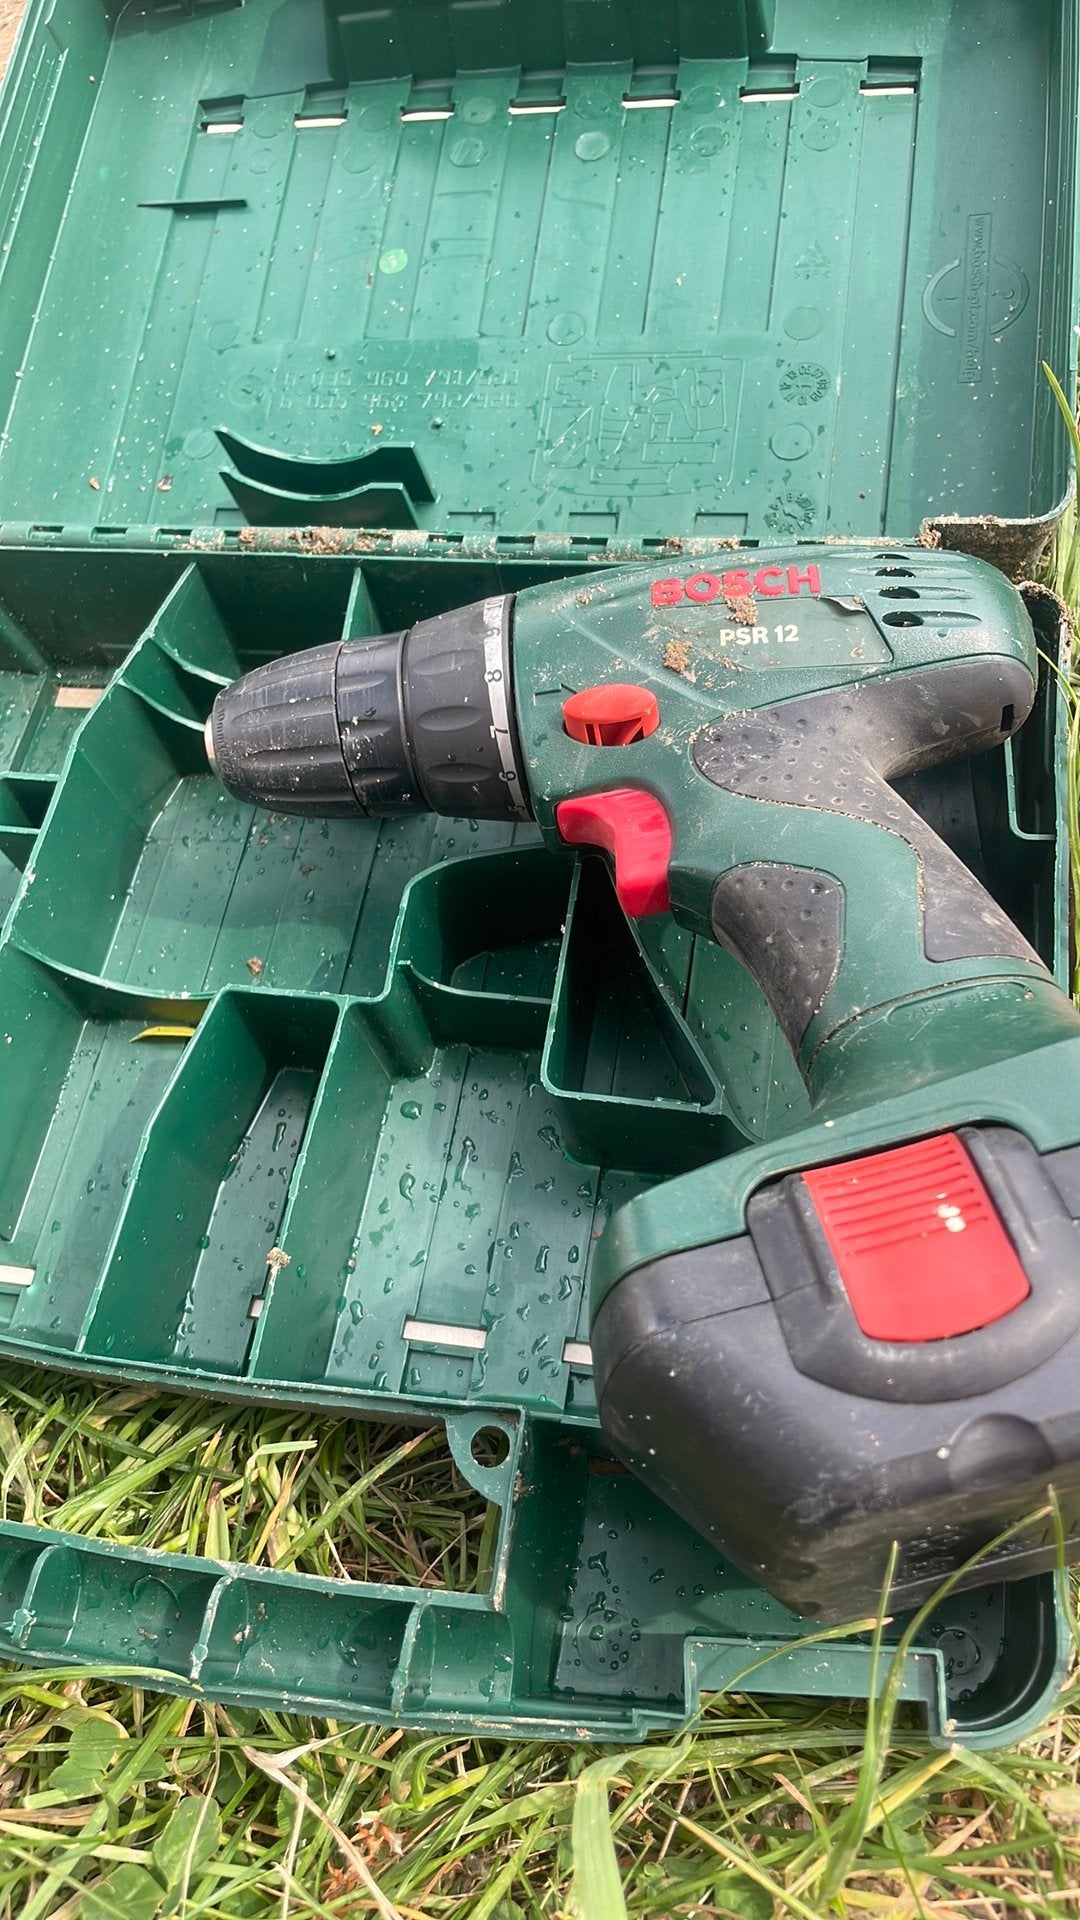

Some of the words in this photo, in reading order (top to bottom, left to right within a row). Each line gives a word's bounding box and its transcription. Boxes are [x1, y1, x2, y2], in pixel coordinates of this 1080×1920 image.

[366, 369, 409, 386] 960
[652, 564, 821, 606] BOSCH
[719, 626, 769, 646] PSR
[774, 624, 800, 643] 12
[484, 669, 502, 683] 8
[490, 725, 508, 738] 7
[498, 770, 516, 782] 6
